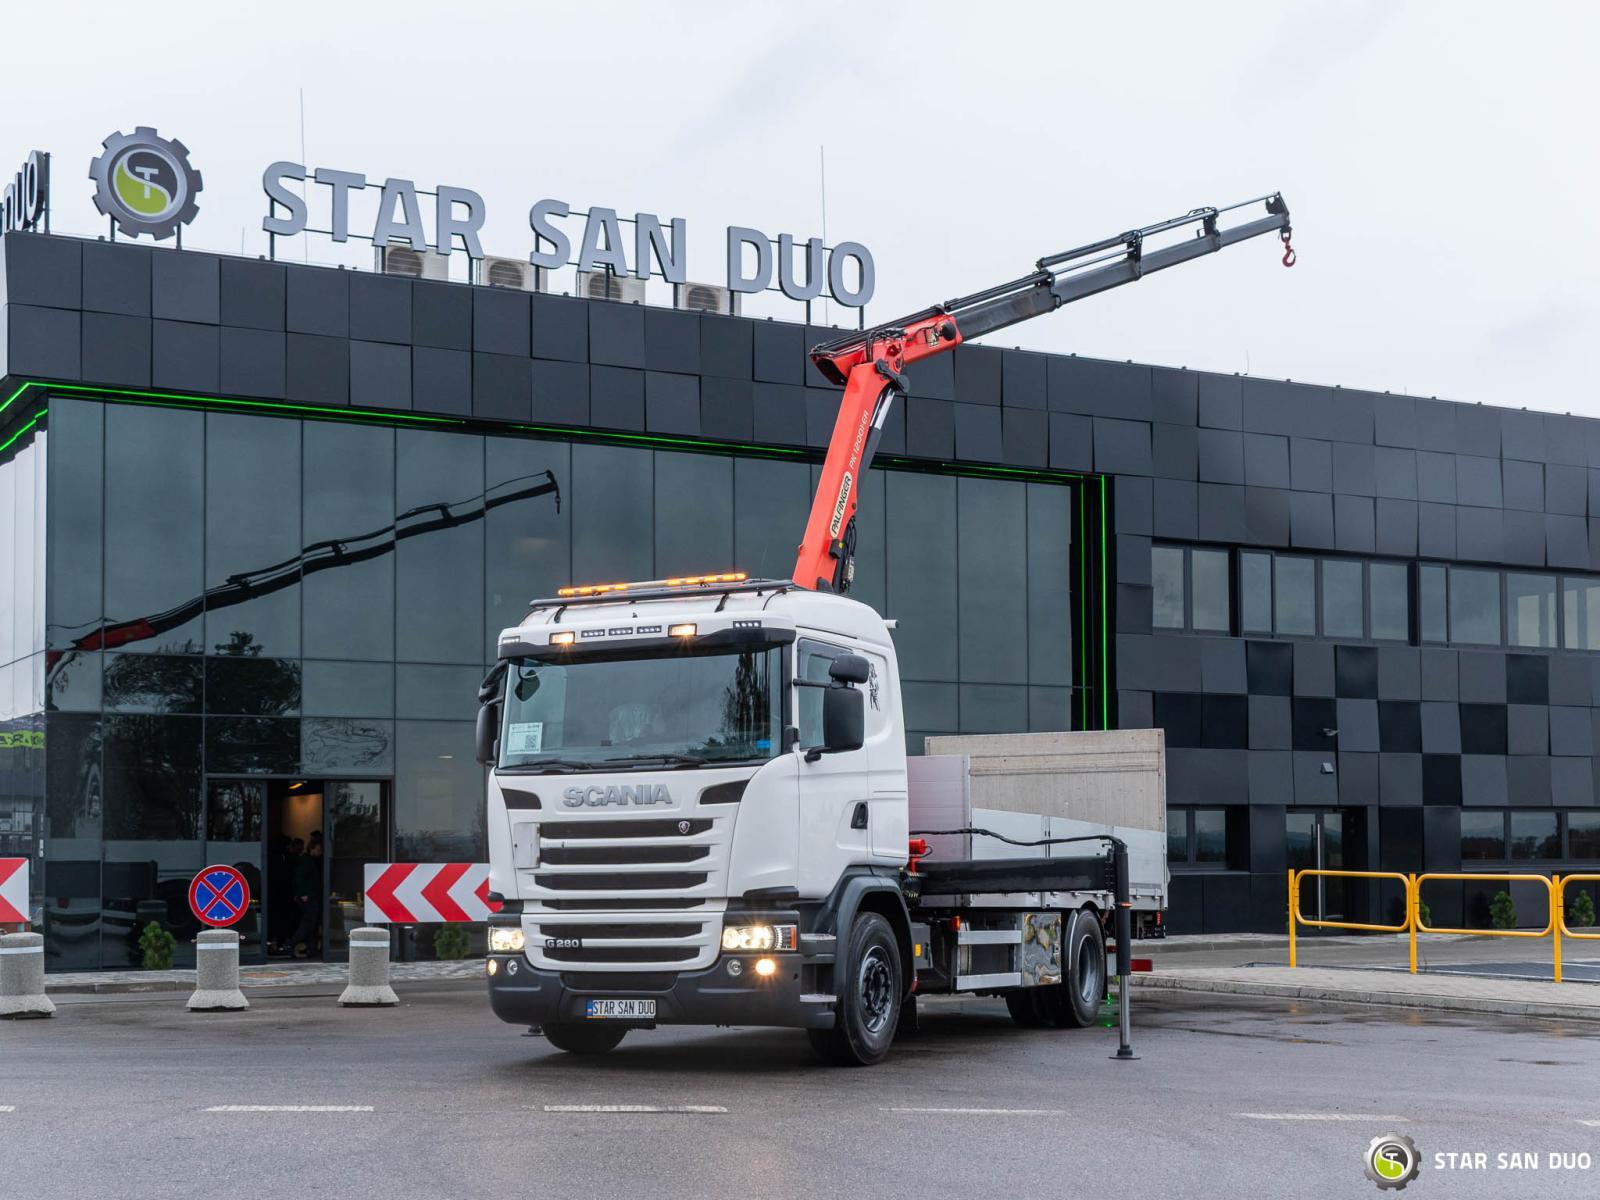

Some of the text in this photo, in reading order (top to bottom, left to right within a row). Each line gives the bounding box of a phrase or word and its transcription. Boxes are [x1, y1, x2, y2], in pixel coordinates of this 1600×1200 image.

[262, 161, 875, 308] STAR SAN DUO
[831, 475, 852, 535] PALFINGER
[562, 784, 673, 808] SCANIA
[593, 1001, 655, 1015] STAR SAN DUO
